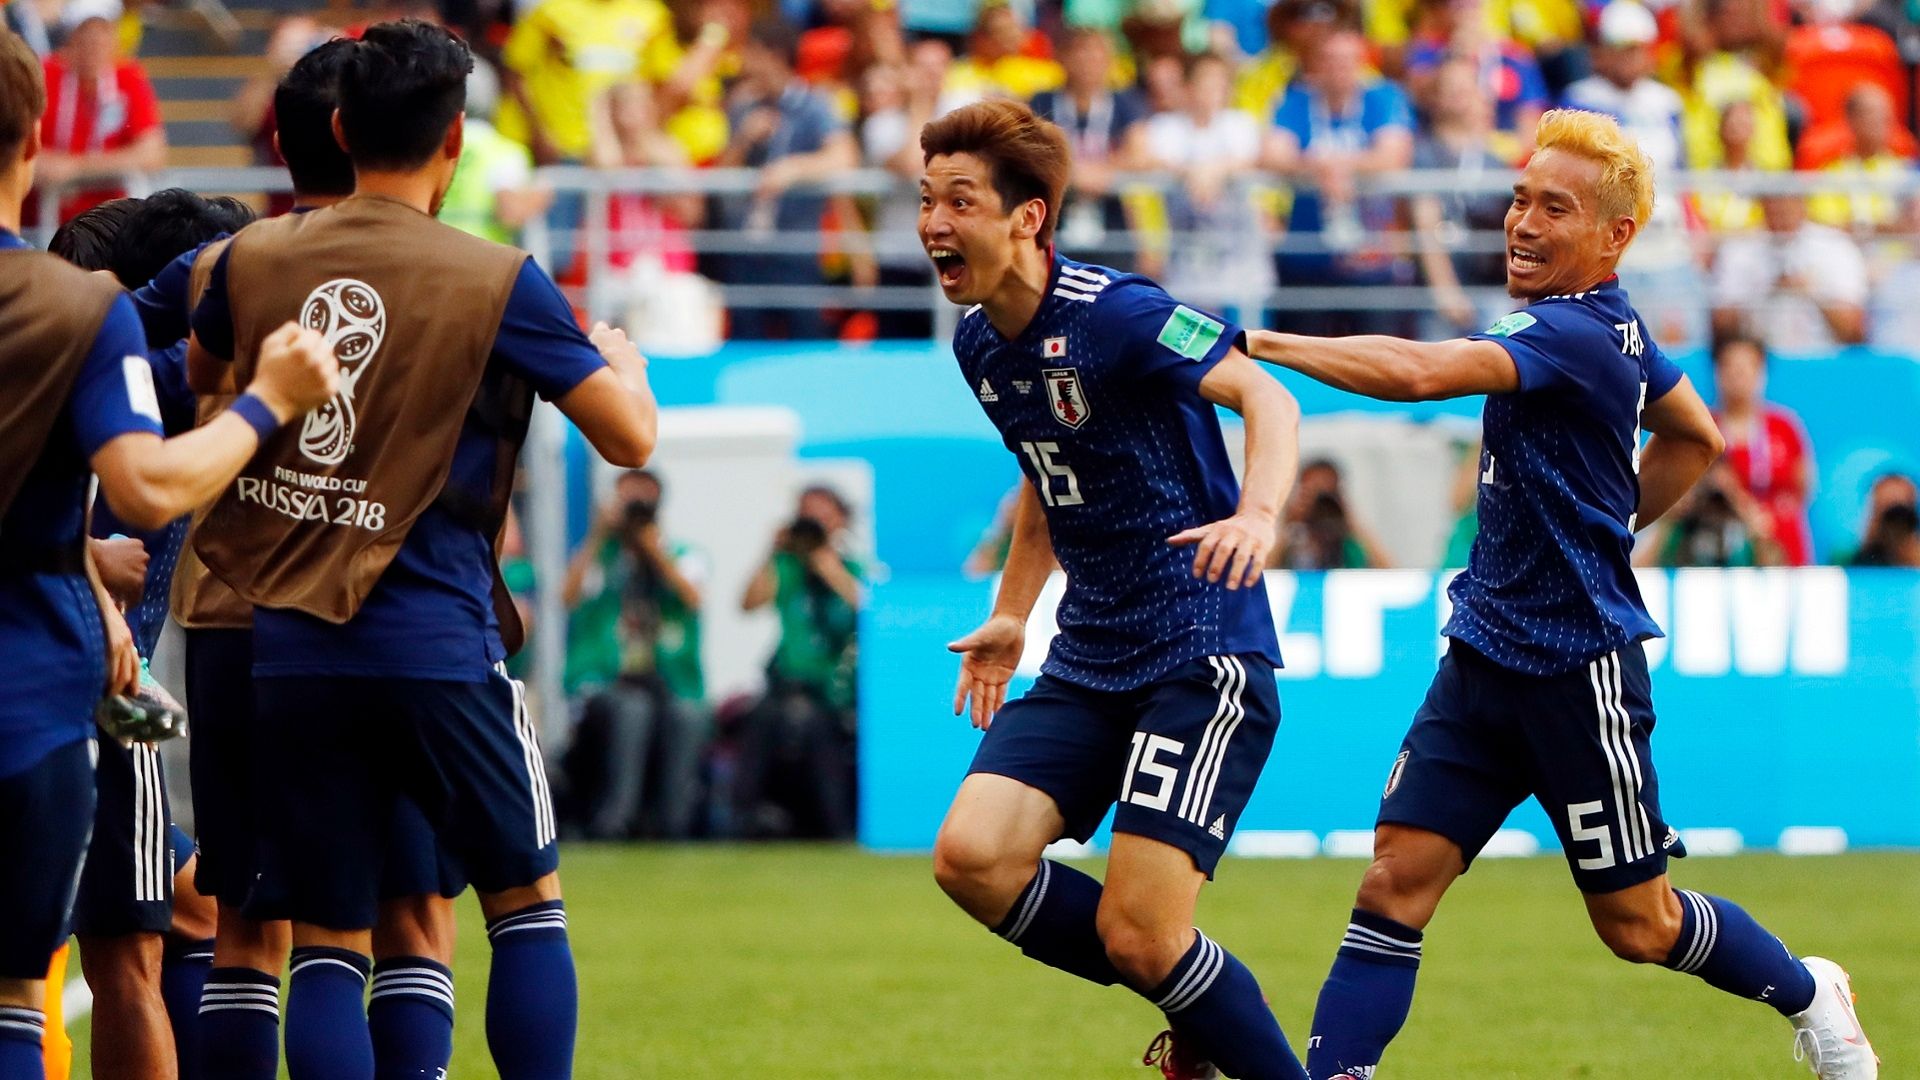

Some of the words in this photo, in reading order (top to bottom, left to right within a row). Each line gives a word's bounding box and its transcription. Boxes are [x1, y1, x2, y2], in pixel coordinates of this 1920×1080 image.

[237, 477, 330, 523] RUSSIA
[332, 497, 386, 531] 218
[274, 465, 298, 485] FIFA
[300, 473, 341, 490] WOLD
[1020, 441, 1084, 506] 15
[1120, 731, 1185, 812] 15
[1567, 800, 1616, 870] 5
